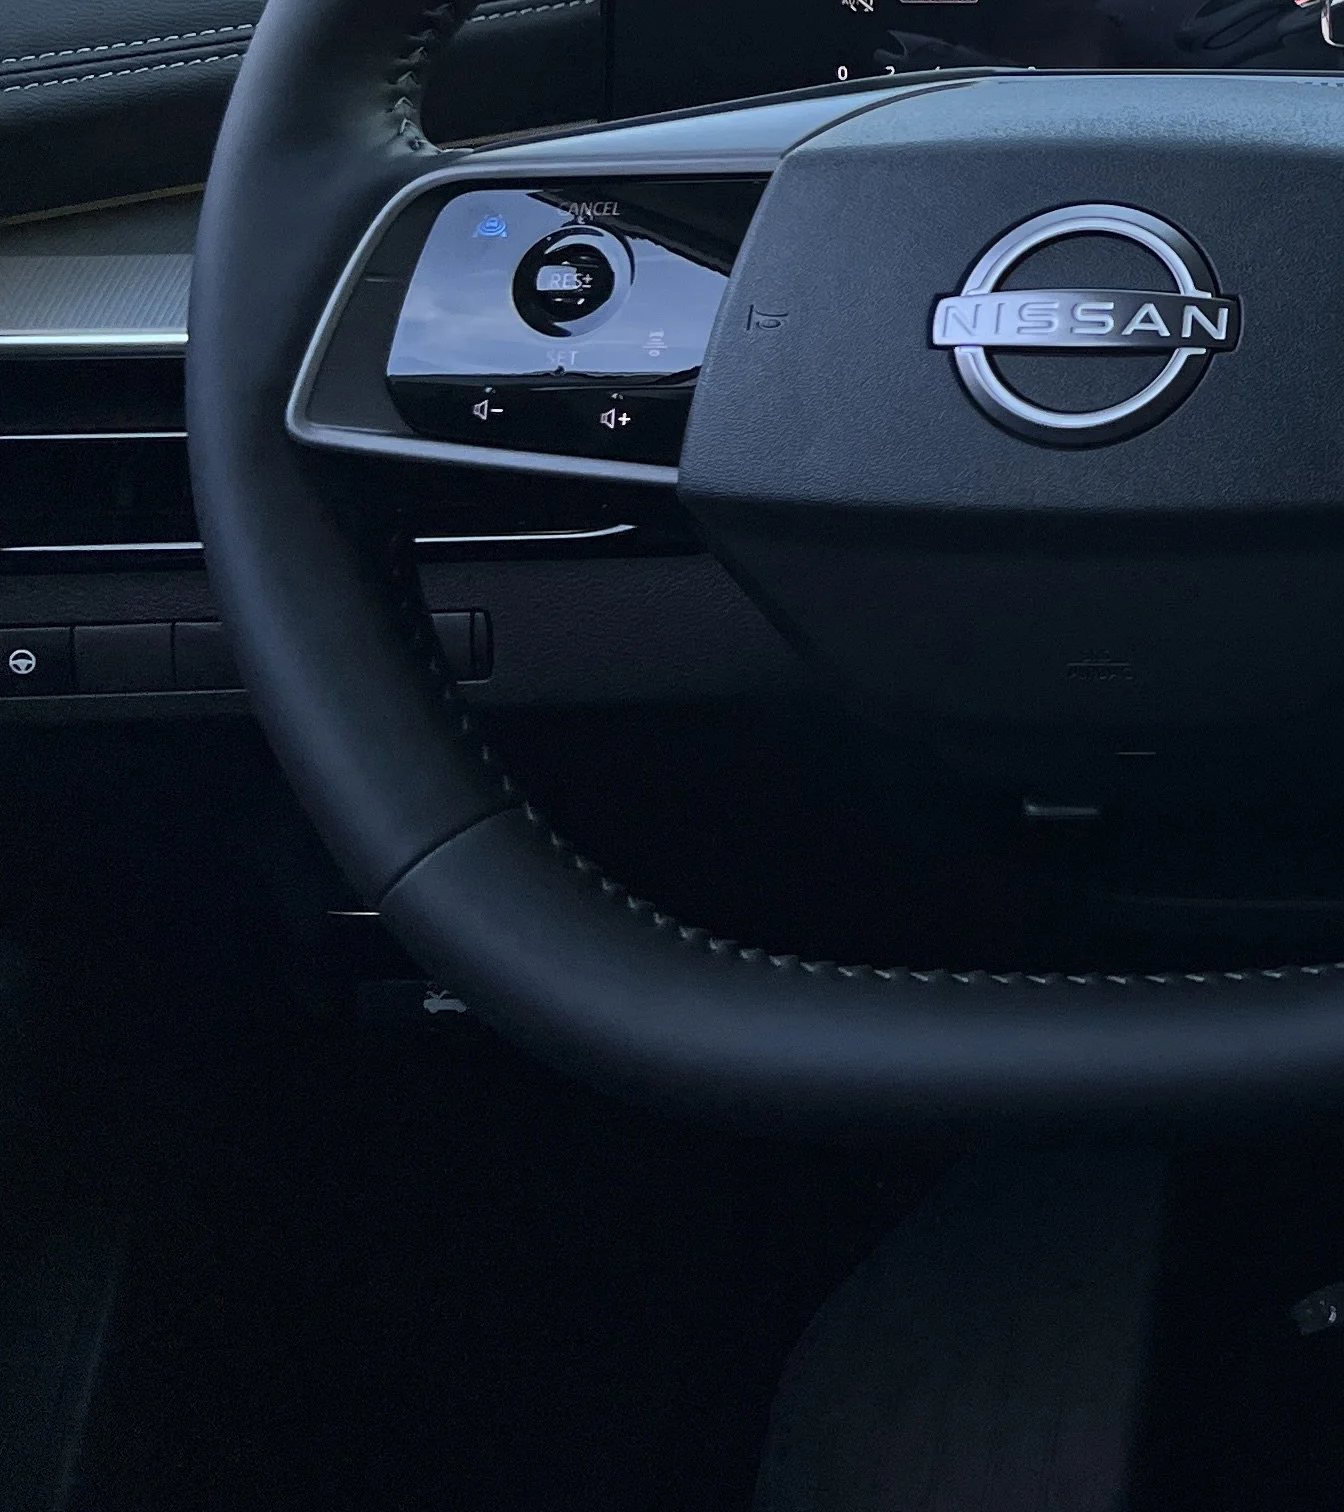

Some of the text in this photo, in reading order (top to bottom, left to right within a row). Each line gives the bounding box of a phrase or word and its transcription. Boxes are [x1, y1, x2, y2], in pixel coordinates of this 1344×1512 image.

[558, 201, 621, 216] CANCEL
[941, 300, 1229, 341] NISSAN
[546, 350, 579, 366] SET
